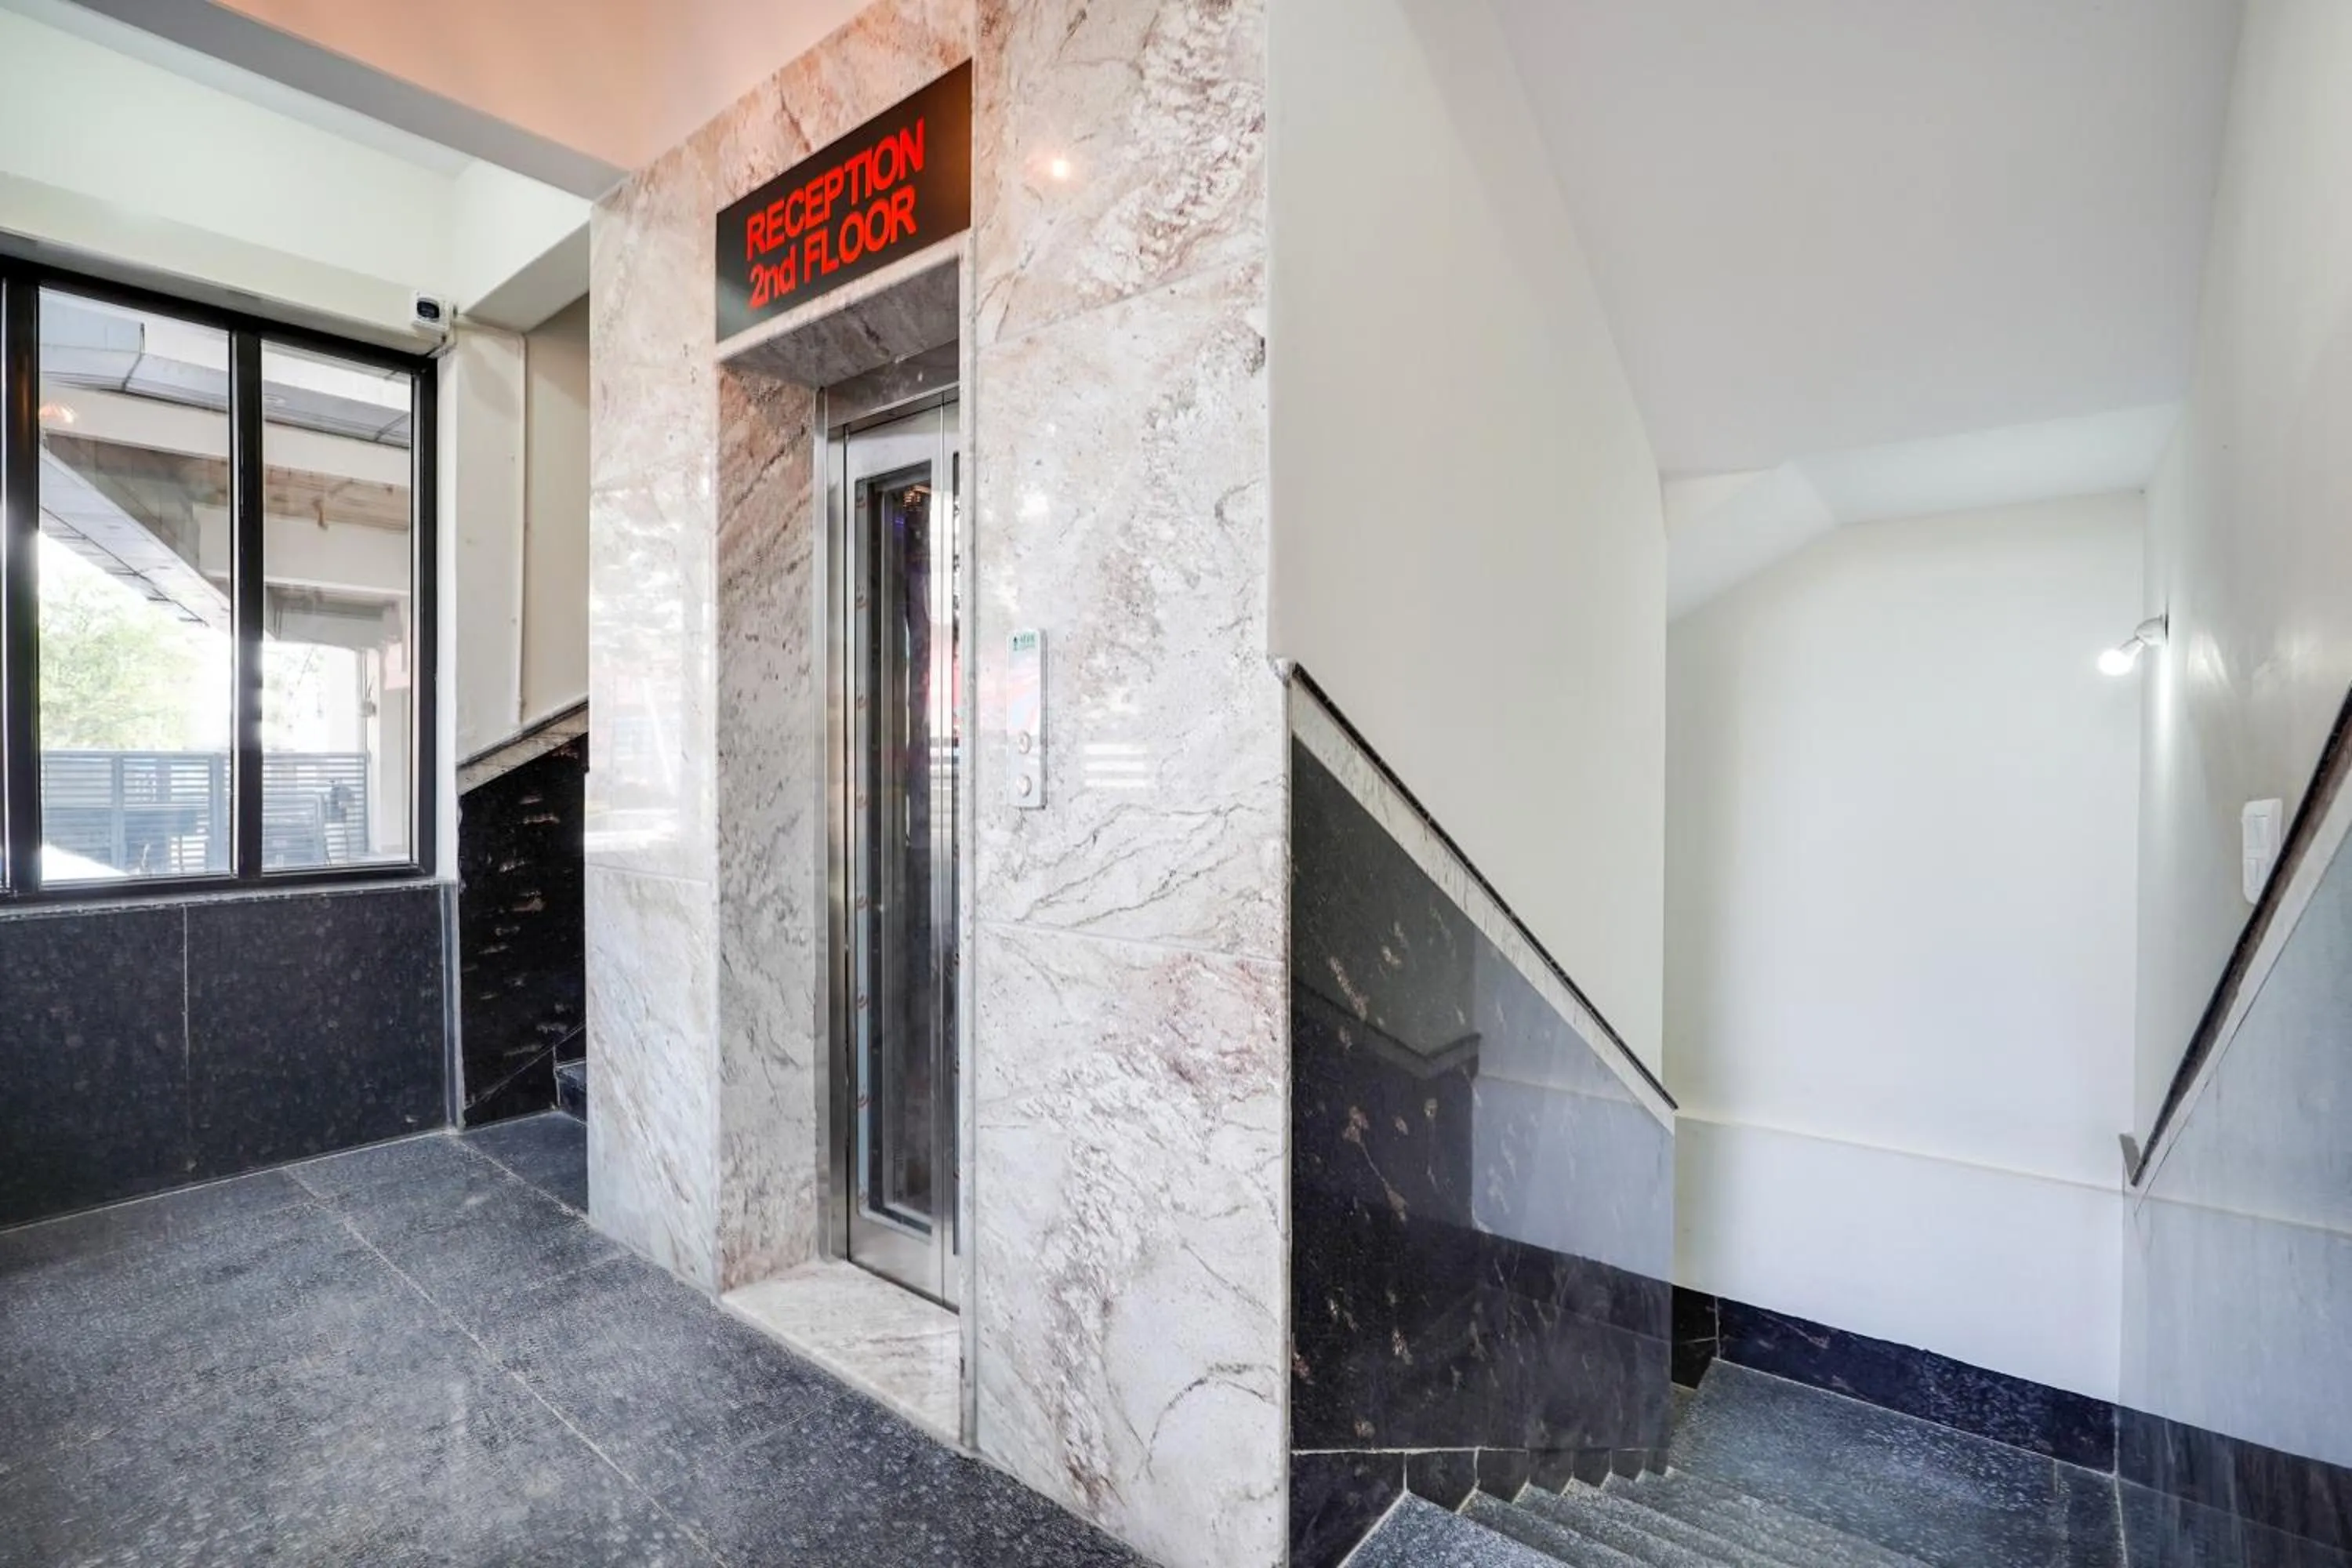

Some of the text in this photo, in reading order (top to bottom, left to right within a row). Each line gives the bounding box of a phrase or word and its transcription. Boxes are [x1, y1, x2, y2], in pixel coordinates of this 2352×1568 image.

[746, 117, 925, 261] RECEPTION
[750, 184, 917, 311] 2nd FLOOR
